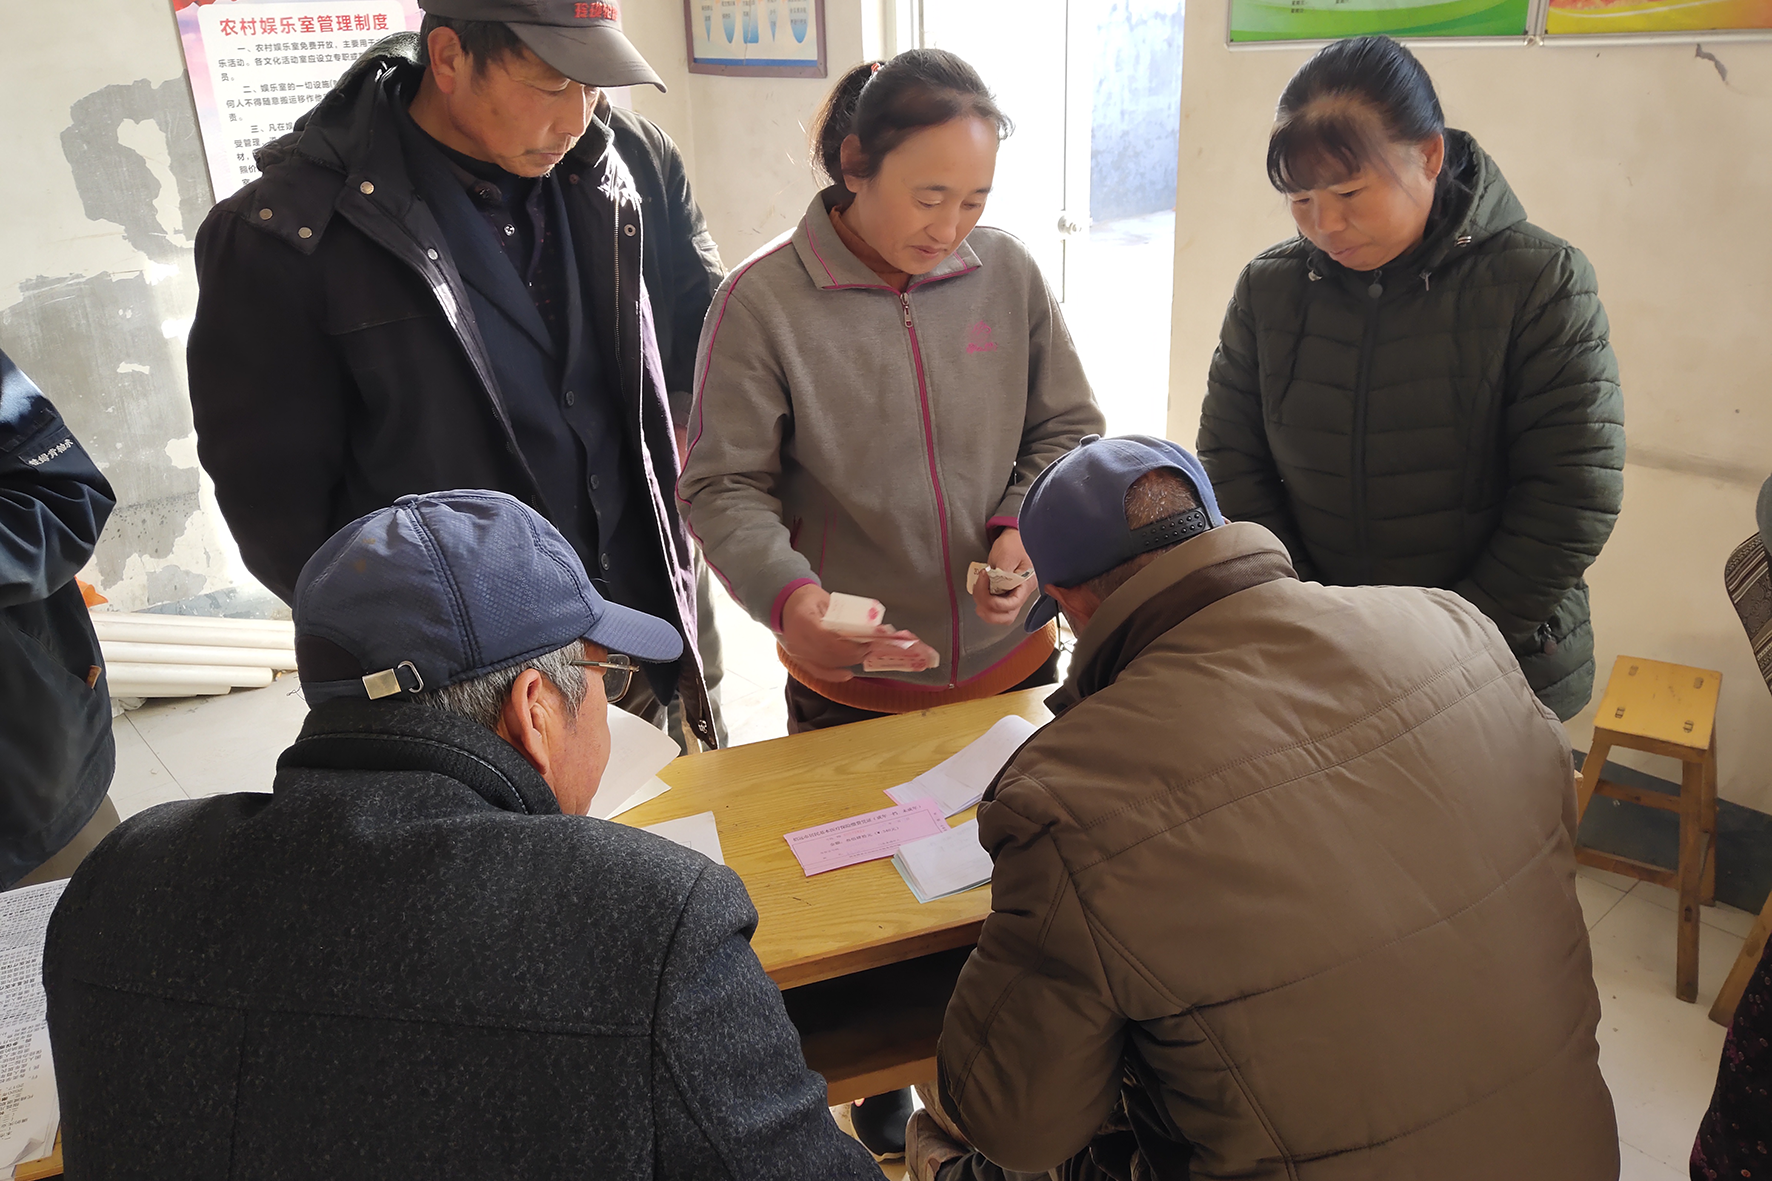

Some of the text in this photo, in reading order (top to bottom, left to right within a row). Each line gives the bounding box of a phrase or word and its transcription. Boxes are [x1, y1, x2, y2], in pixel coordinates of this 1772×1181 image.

[219, 13, 389, 36] 农村娱乐室管理制度
[237, 39, 380, 52] 一、农村娱乐室免费开放，主要用于
